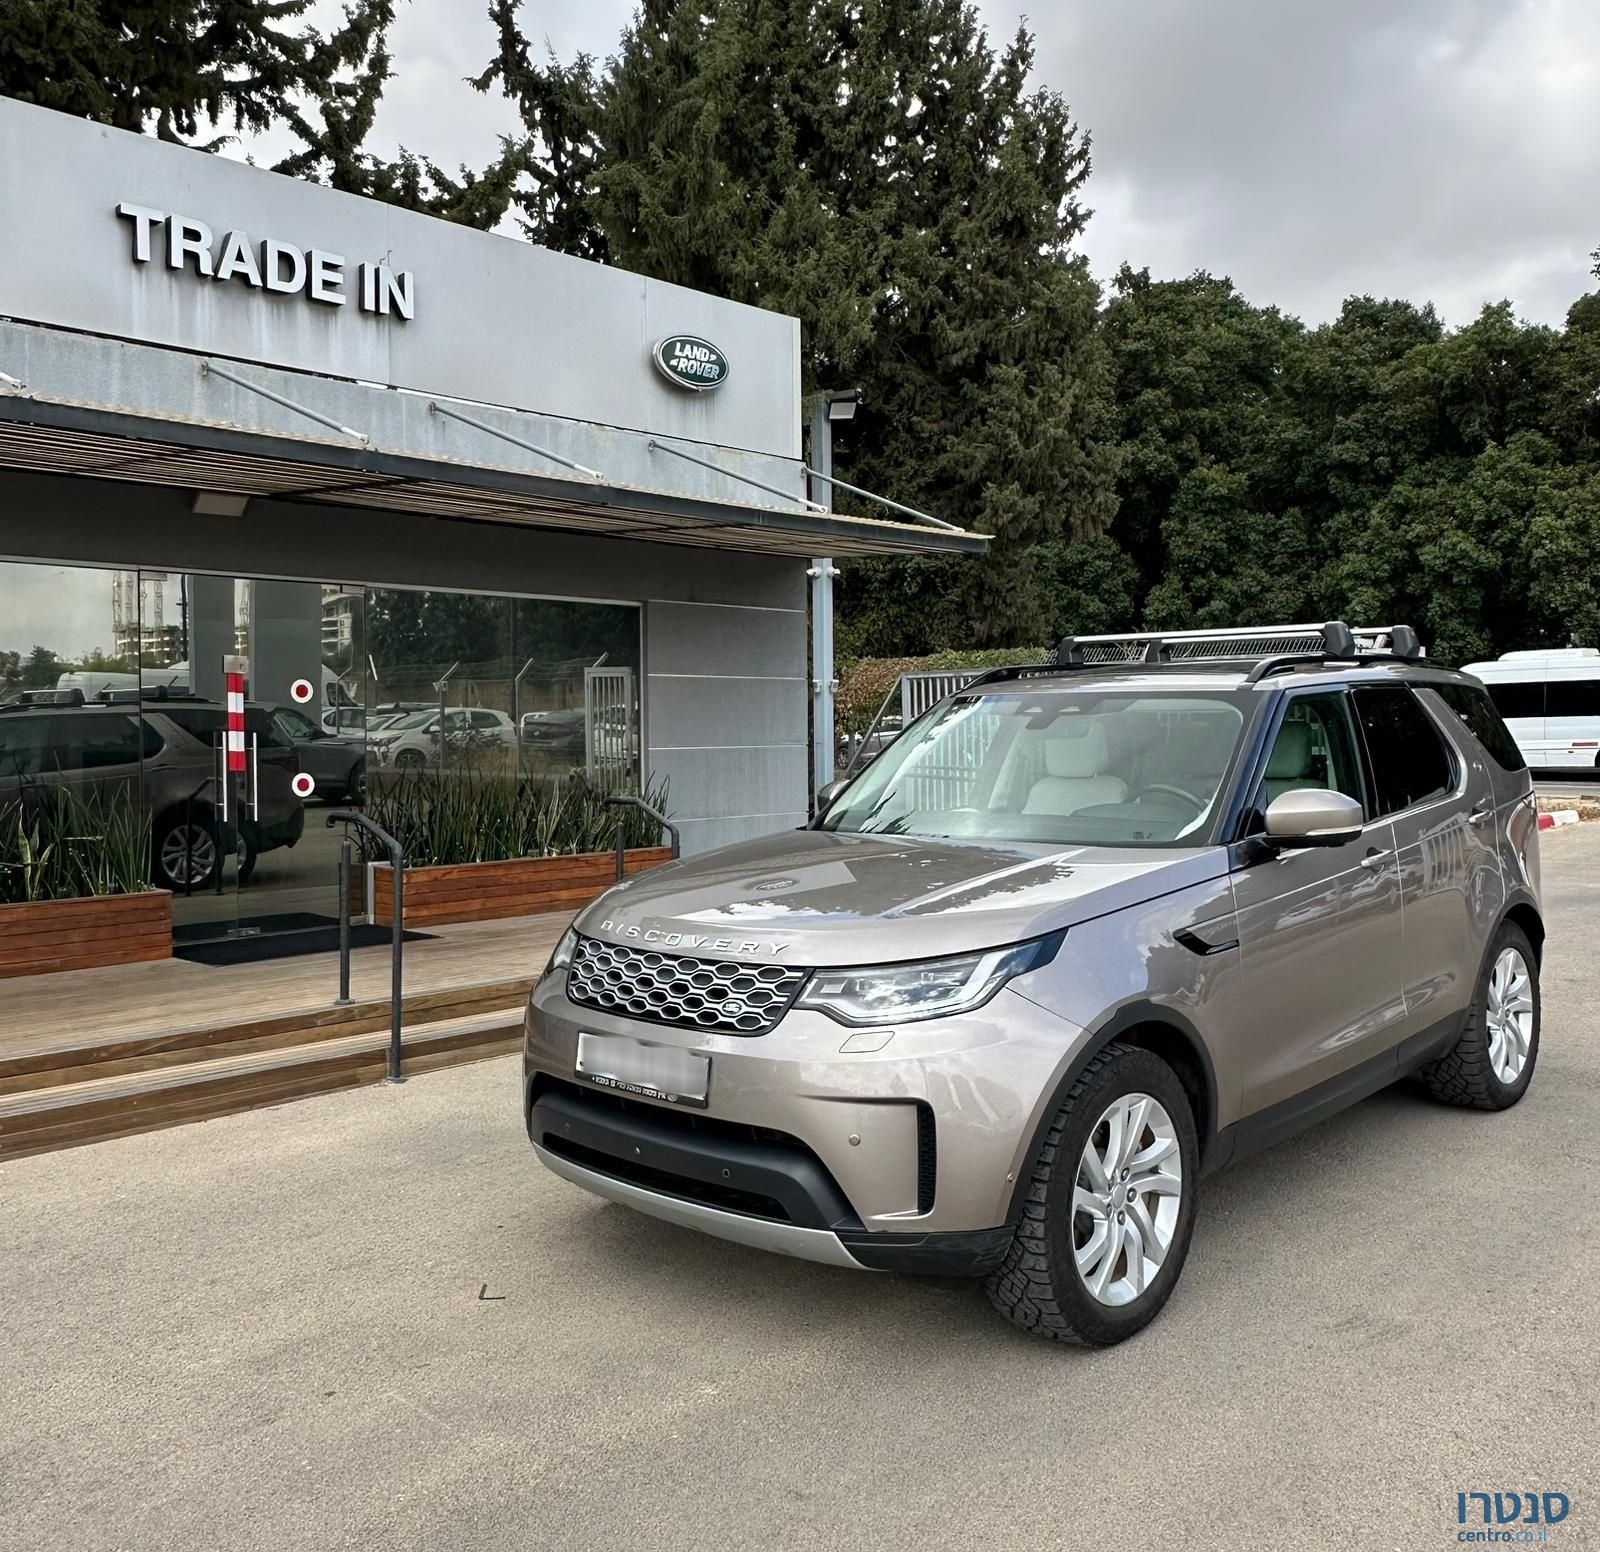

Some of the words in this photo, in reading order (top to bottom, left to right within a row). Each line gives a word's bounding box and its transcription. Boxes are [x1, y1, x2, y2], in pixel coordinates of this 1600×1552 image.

[116, 202, 346, 306] TRADE
[359, 262, 414, 320] IN
[674, 342, 710, 362] LAND
[677, 357, 720, 379] ROVER
[600, 919, 790, 956] DISCOVERY
